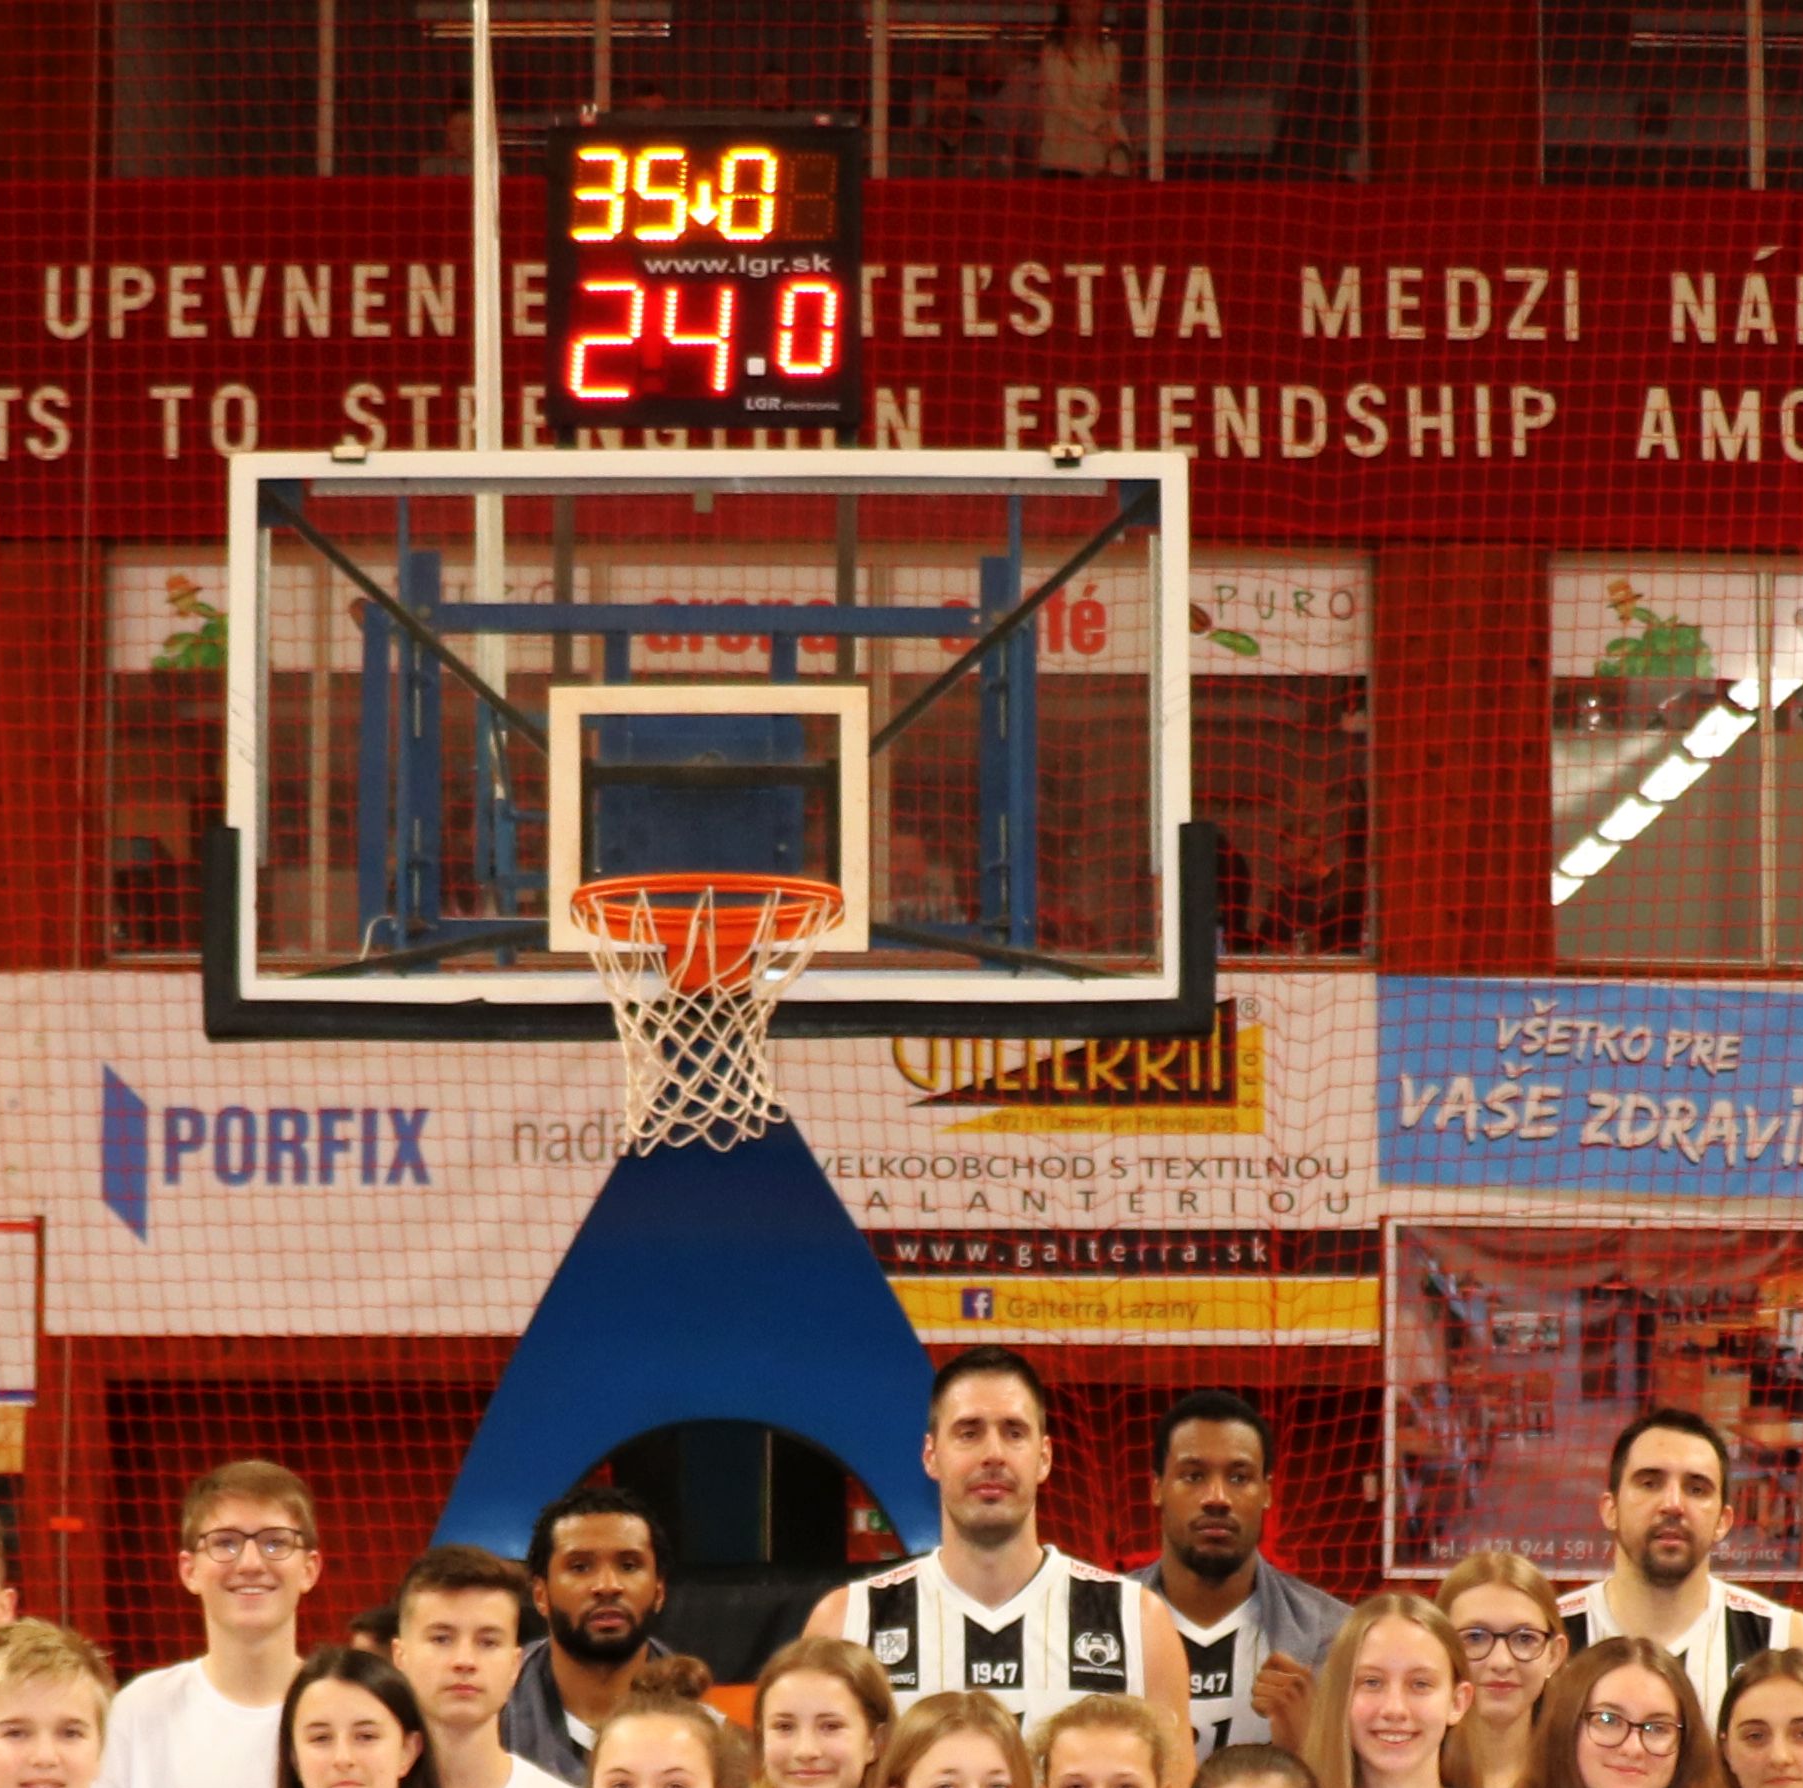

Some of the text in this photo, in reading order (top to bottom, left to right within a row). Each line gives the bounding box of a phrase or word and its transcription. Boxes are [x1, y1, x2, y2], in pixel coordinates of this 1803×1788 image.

[644, 254, 832, 278] www.lgr.sk
[1300, 266, 1581, 342] MEDZI
[569, 280, 840, 399] 24.0
[149, 384, 259, 459] TO
[1006, 384, 1557, 460] FRIENDSHIP
[745, 397, 781, 411] LGR
[1215, 584, 1356, 621] PURO
[1496, 999, 1743, 1076] VŠETKO PRE
[1398, 1061, 1562, 1142] VAŠE
[162, 1106, 432, 1187] PORFIX
[1111, 1156, 1127, 1180] S
[1140, 1156, 1351, 1181] TEXTILNOU
[897, 1239, 1270, 1268] www.galterra.sk
[971, 1662, 1019, 1685] 1947
